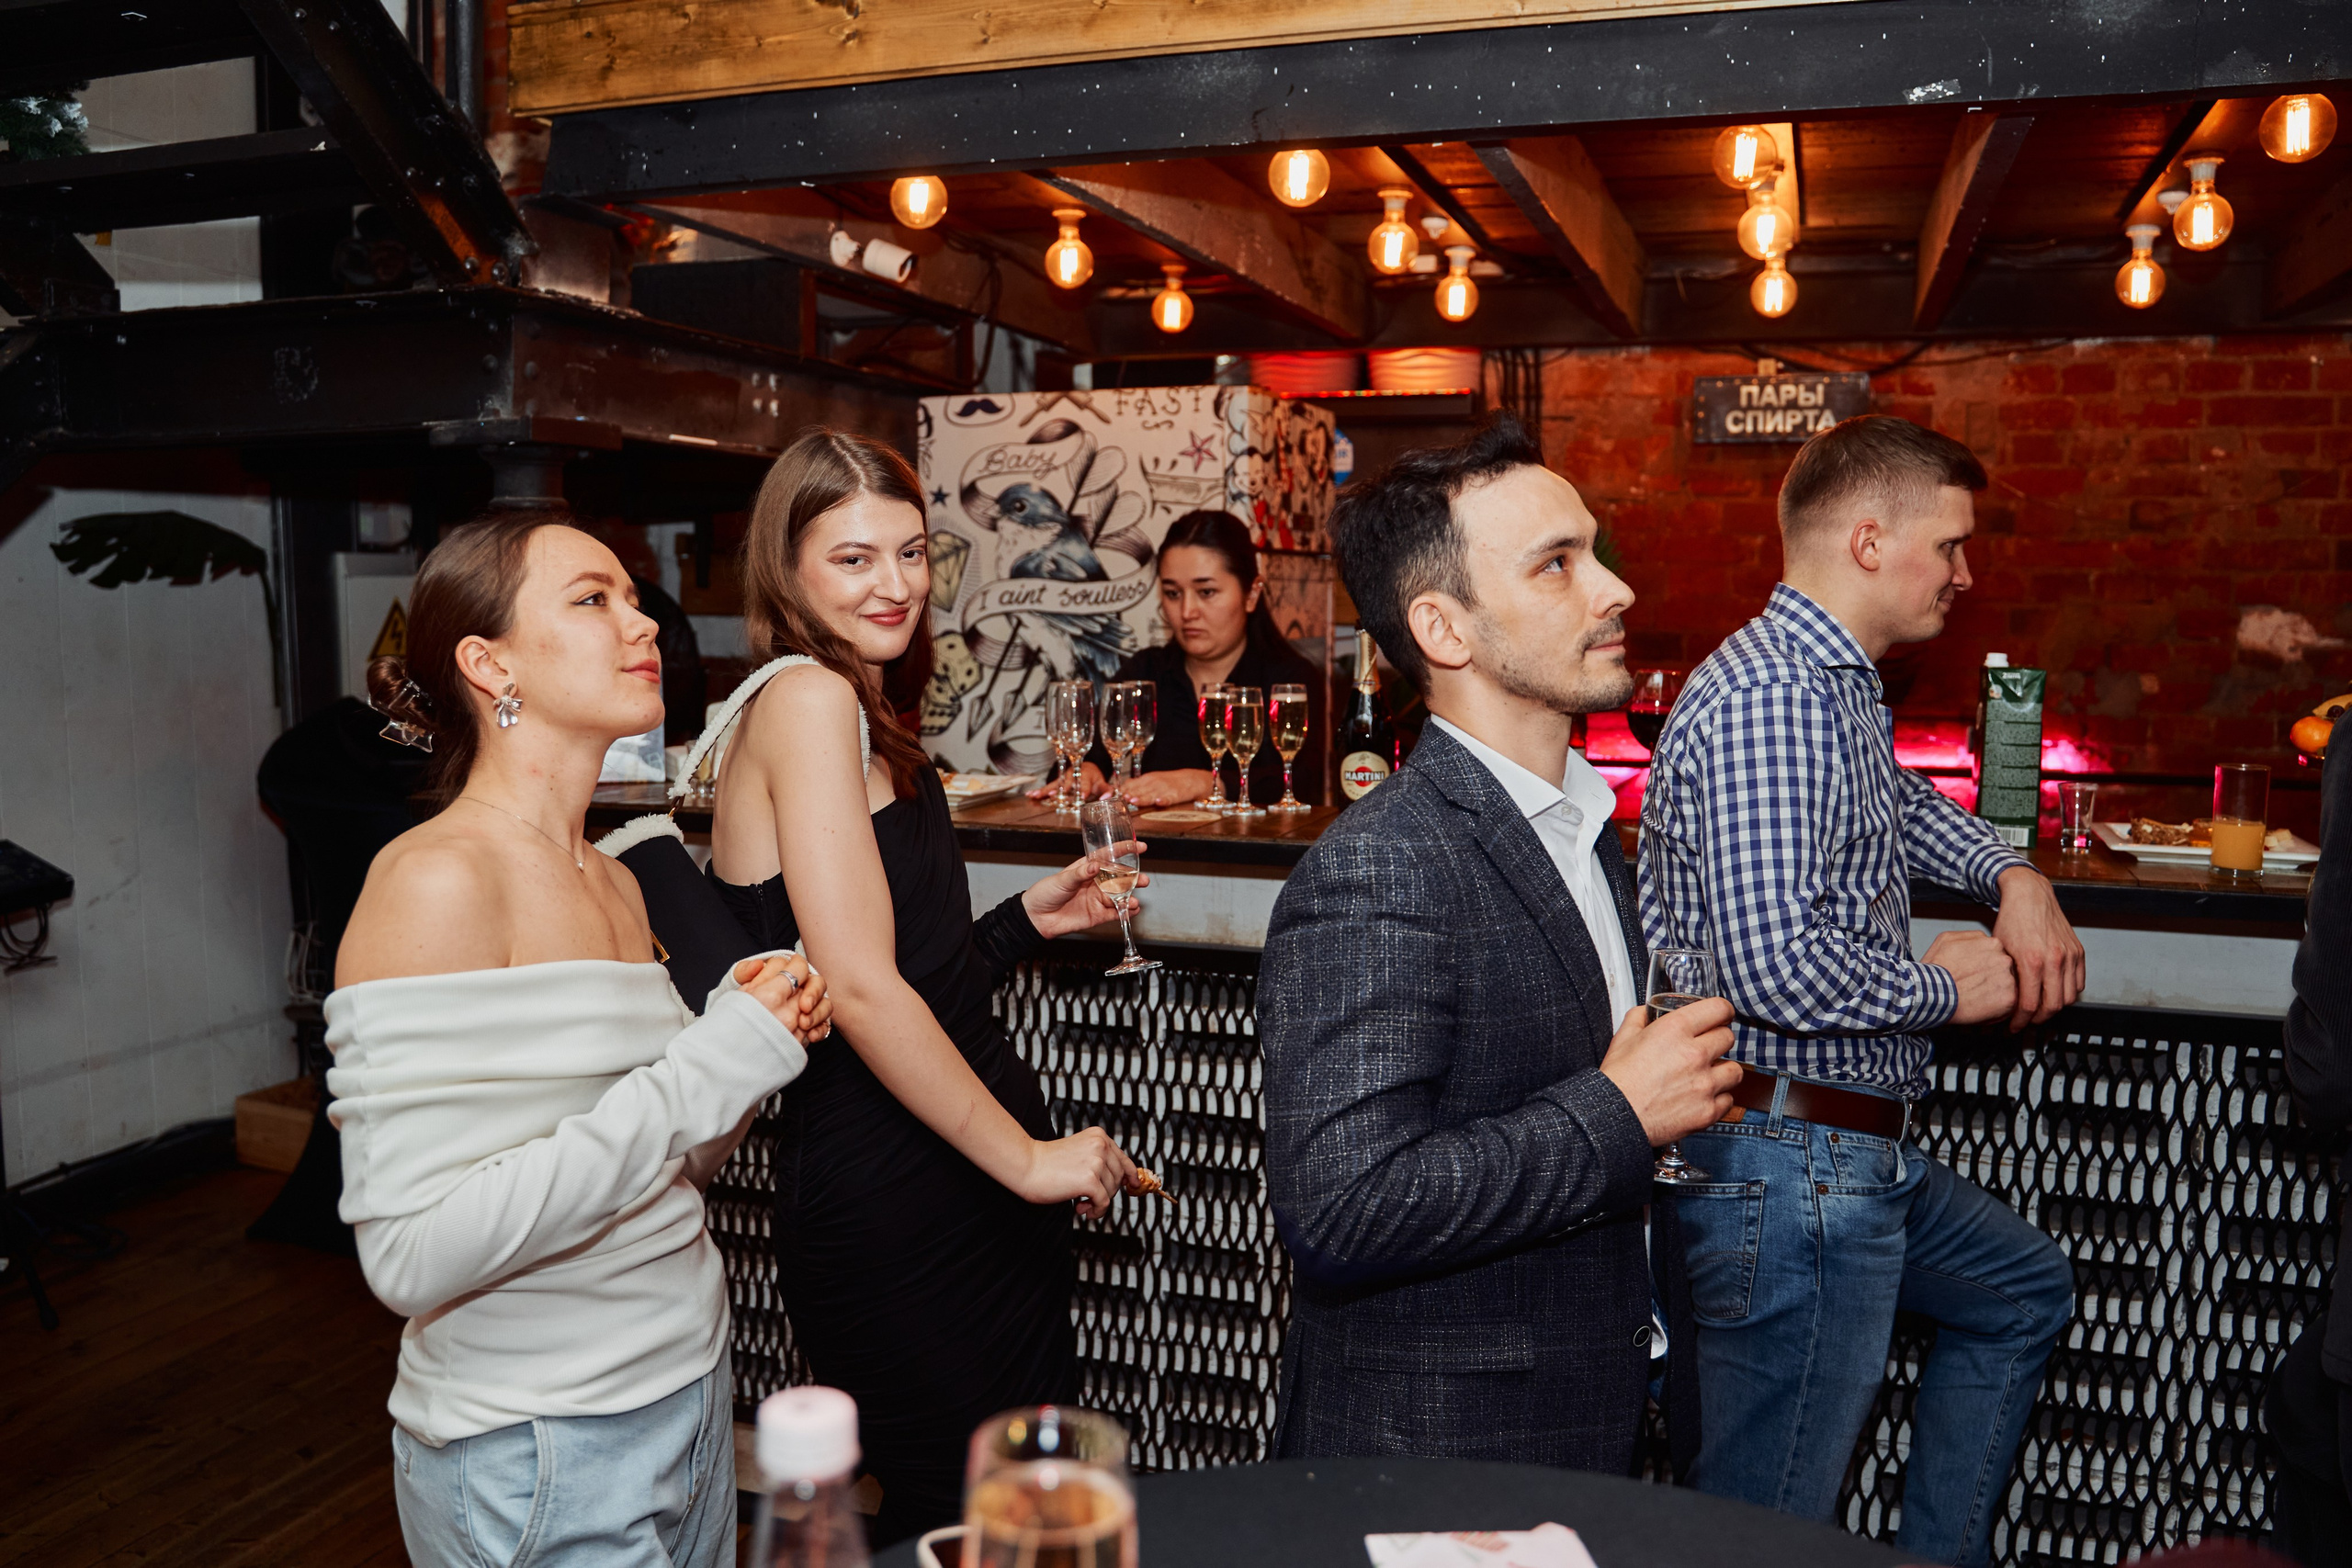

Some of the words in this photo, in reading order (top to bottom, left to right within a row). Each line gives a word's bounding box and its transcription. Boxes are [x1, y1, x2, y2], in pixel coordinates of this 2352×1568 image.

[1113, 386, 1205, 415] FAST
[1739, 383, 1825, 407] ПАРЫ
[1724, 409, 1837, 434] СПИРТА
[978, 445, 1059, 480] Baby
[1058, 579, 1148, 607] soulless
[1345, 772, 1385, 781] MARTINI
